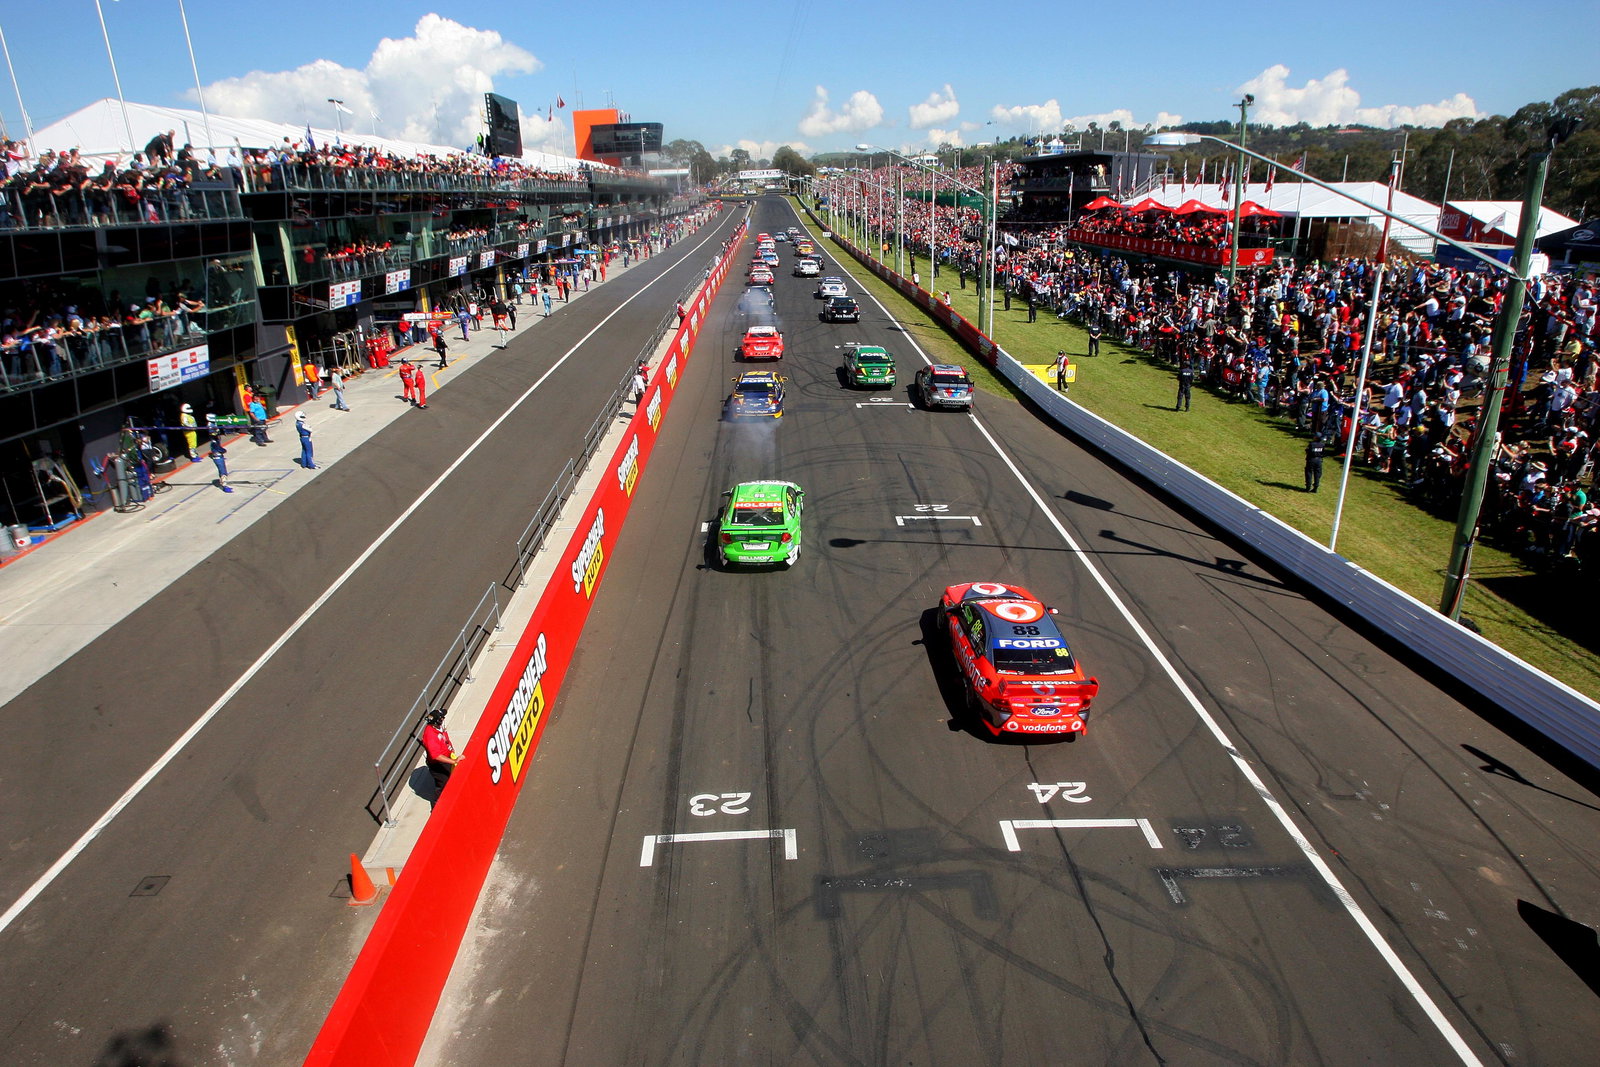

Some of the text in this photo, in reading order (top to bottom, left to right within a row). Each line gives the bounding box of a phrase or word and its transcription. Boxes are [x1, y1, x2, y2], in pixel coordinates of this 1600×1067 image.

[914, 504, 949, 512] 22
[572, 507, 605, 594] SUPERCHEAP
[588, 549, 601, 588] AUTO
[1013, 625, 1040, 635] 88
[998, 639, 1060, 648] FORD
[1055, 648, 1069, 657] 88
[487, 632, 547, 784] SUPERCHEAP
[1036, 708, 1056, 716] Ford
[514, 696, 539, 764] AUTO
[1022, 725, 1067, 733] vodafone
[1026, 782, 1092, 803] 24
[690, 792, 751, 816] 23
